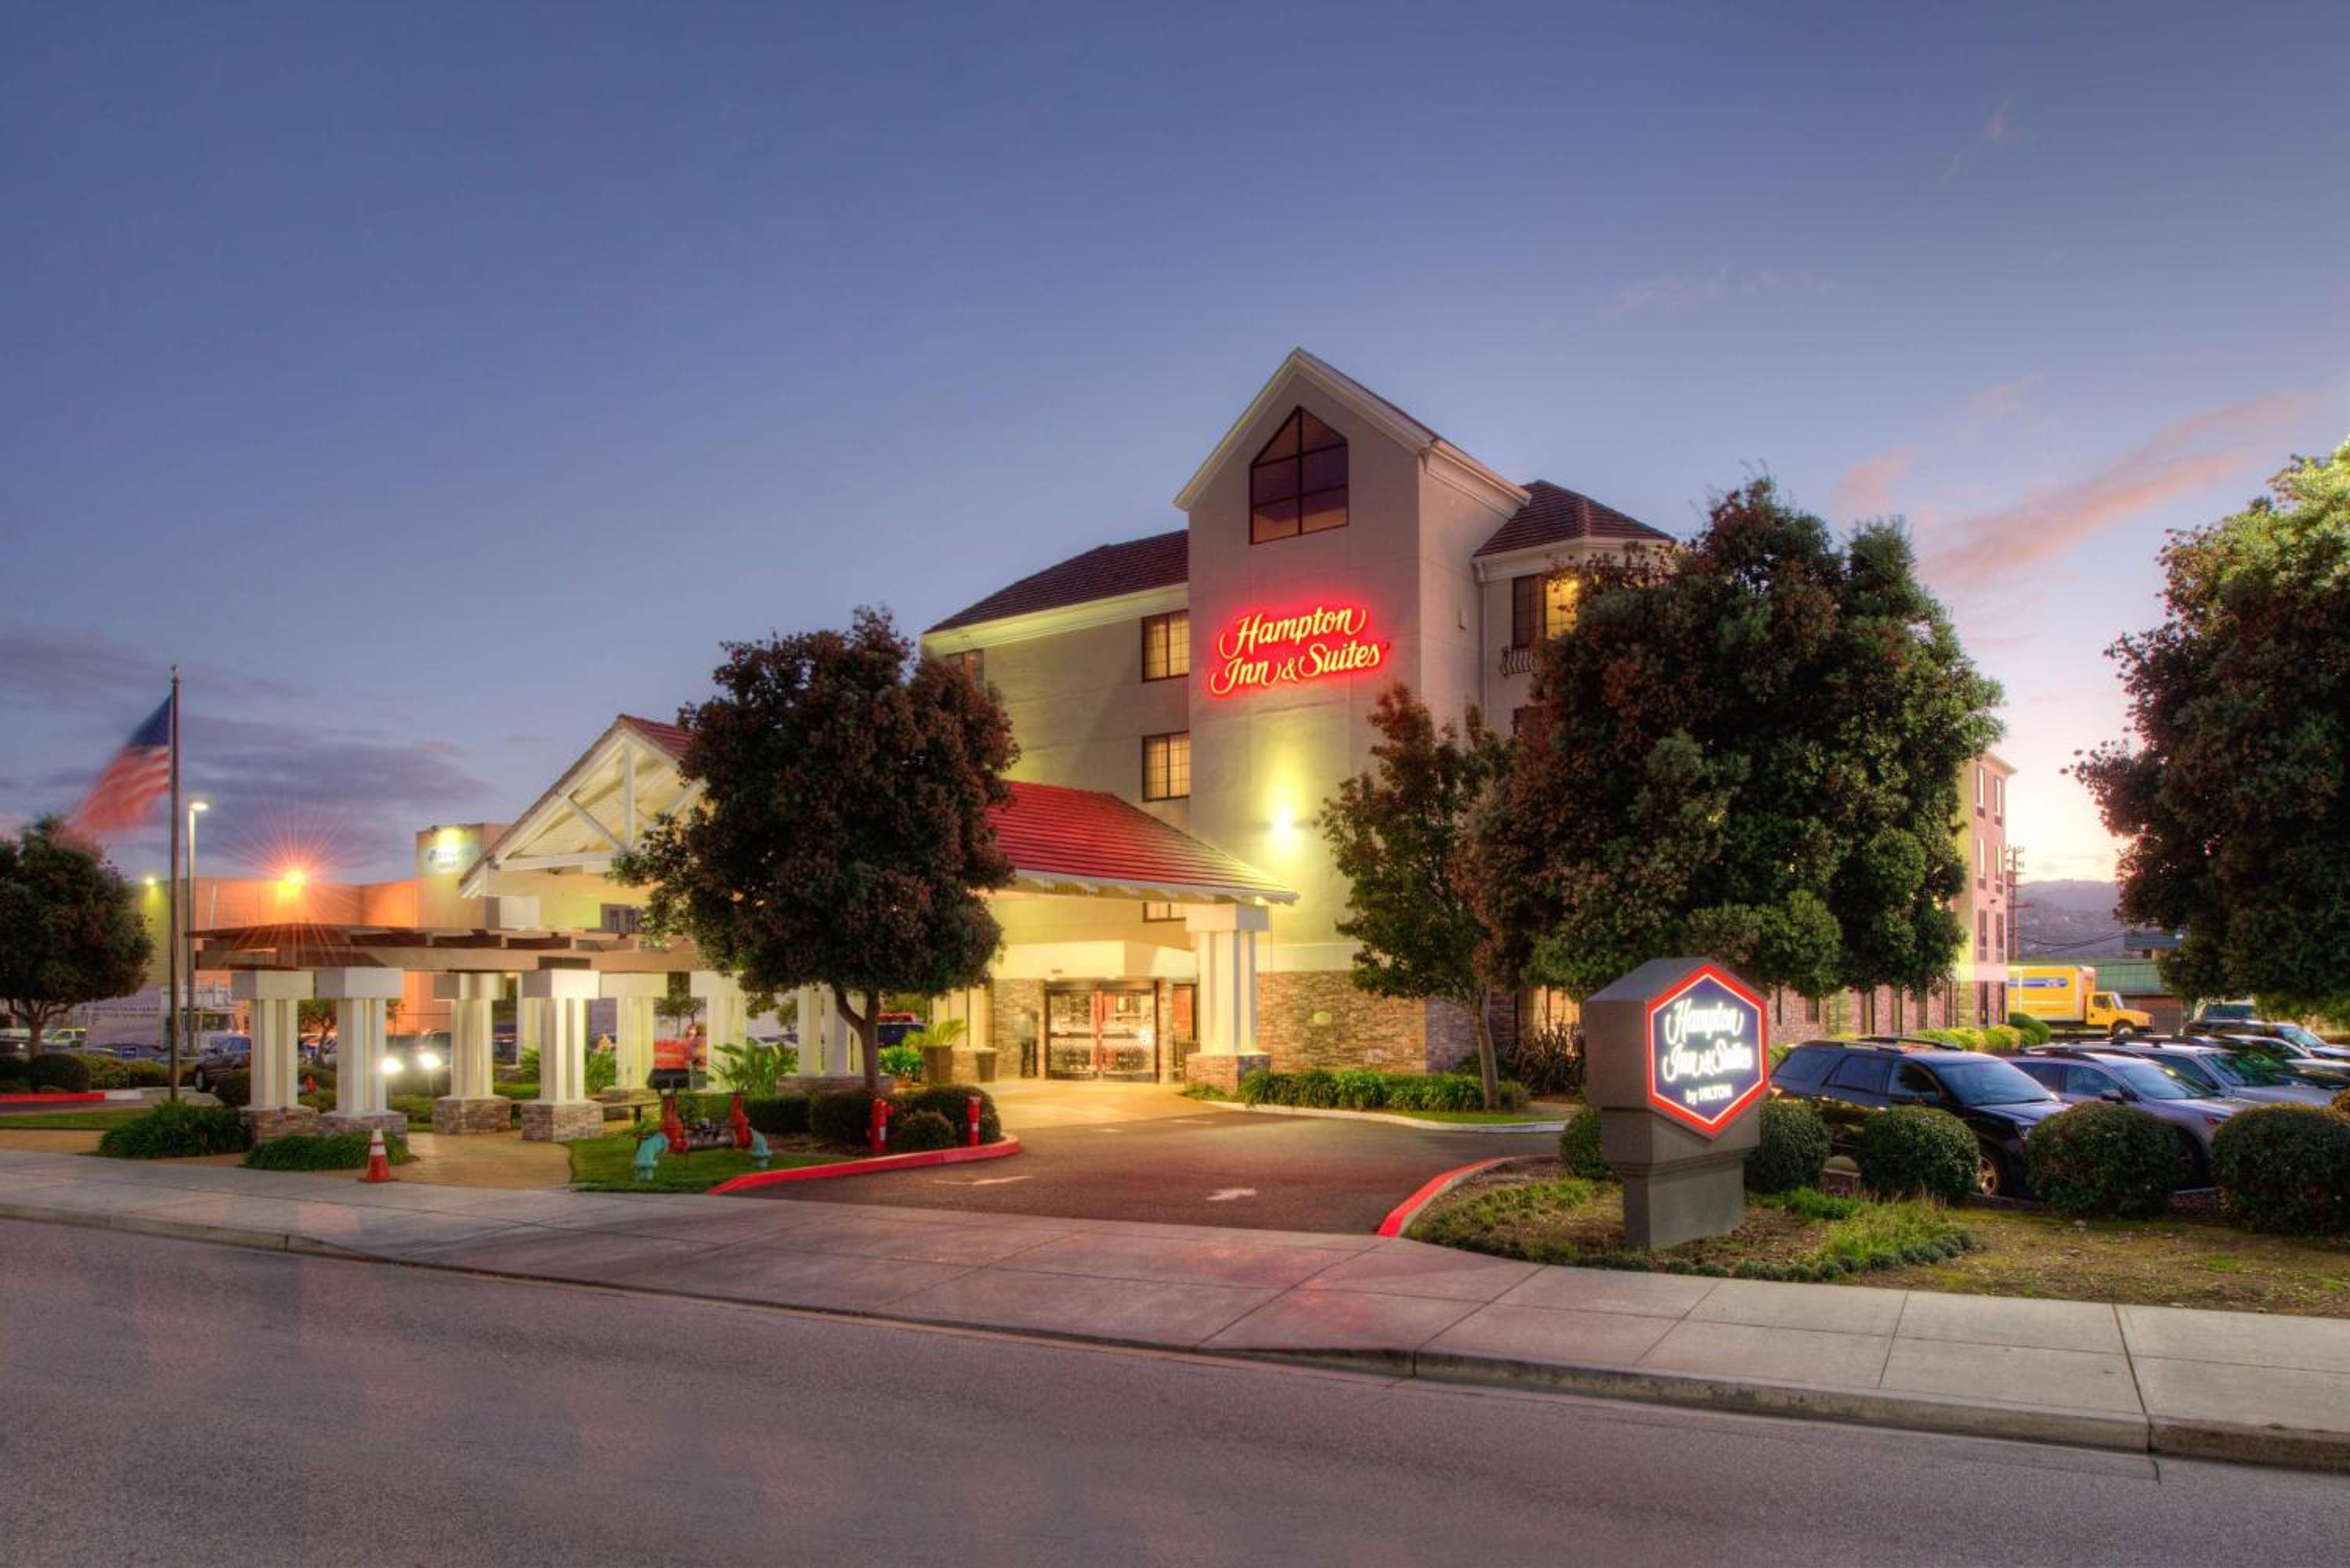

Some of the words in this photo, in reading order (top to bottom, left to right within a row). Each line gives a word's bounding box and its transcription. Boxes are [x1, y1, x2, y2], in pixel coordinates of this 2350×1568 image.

[1219, 606, 1366, 659] Hampton
[1210, 657, 1281, 695] Inn
[1282, 658, 1298, 681] &
[1298, 640, 1379, 677] Suites
[1665, 998, 1744, 1045] Hampton
[1686, 1089, 1697, 1105] by
[1698, 1084, 1733, 1101] HILTON
